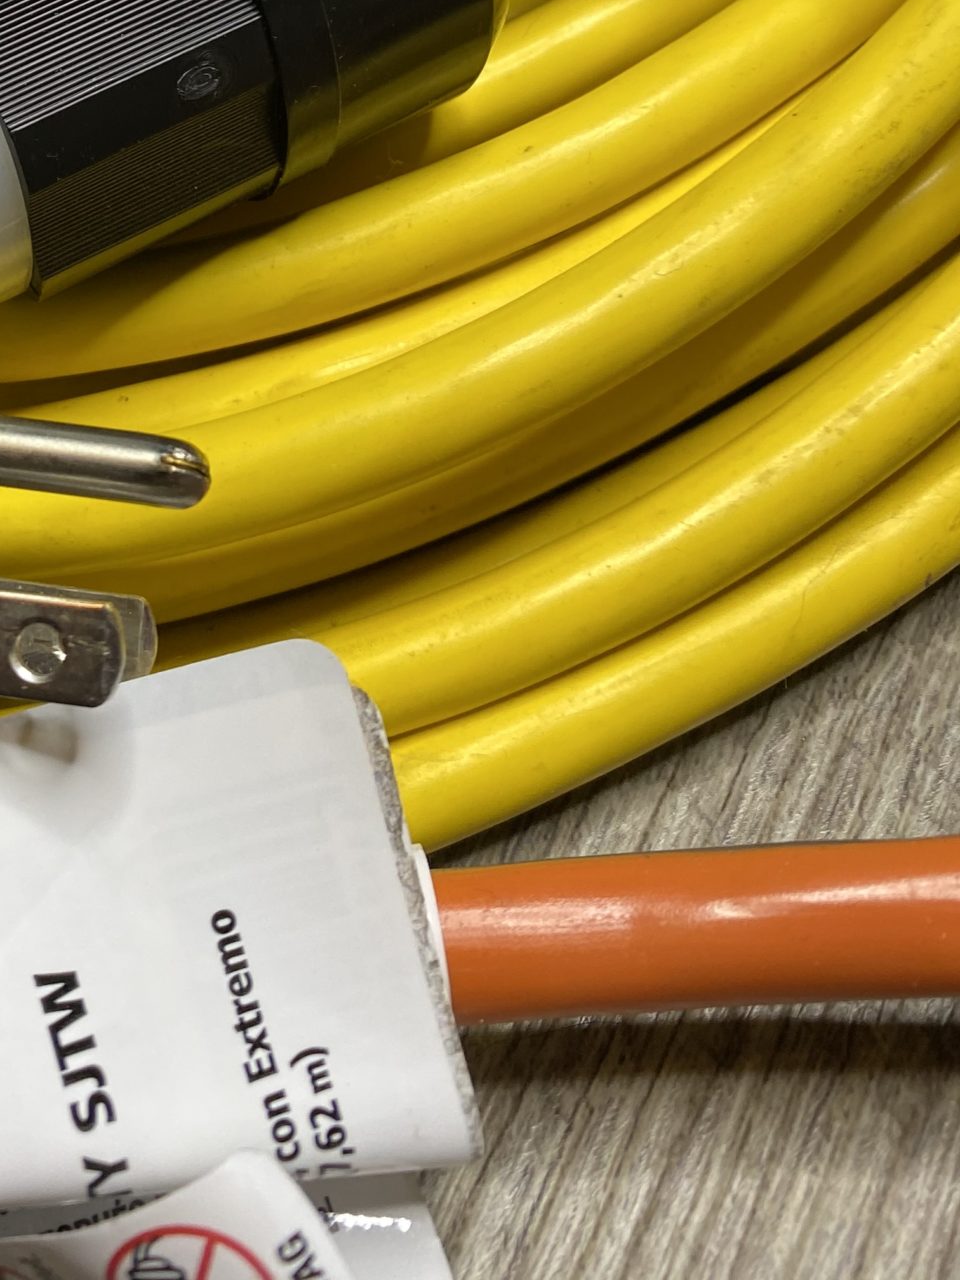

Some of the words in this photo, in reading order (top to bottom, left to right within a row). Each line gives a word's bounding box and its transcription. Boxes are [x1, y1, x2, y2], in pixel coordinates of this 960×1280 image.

[33, 970, 118, 1133] SJTW
[210, 907, 279, 1083] Extremo
[262, 1088, 301, 1162] con
[289, 1045, 333, 1095] m)
